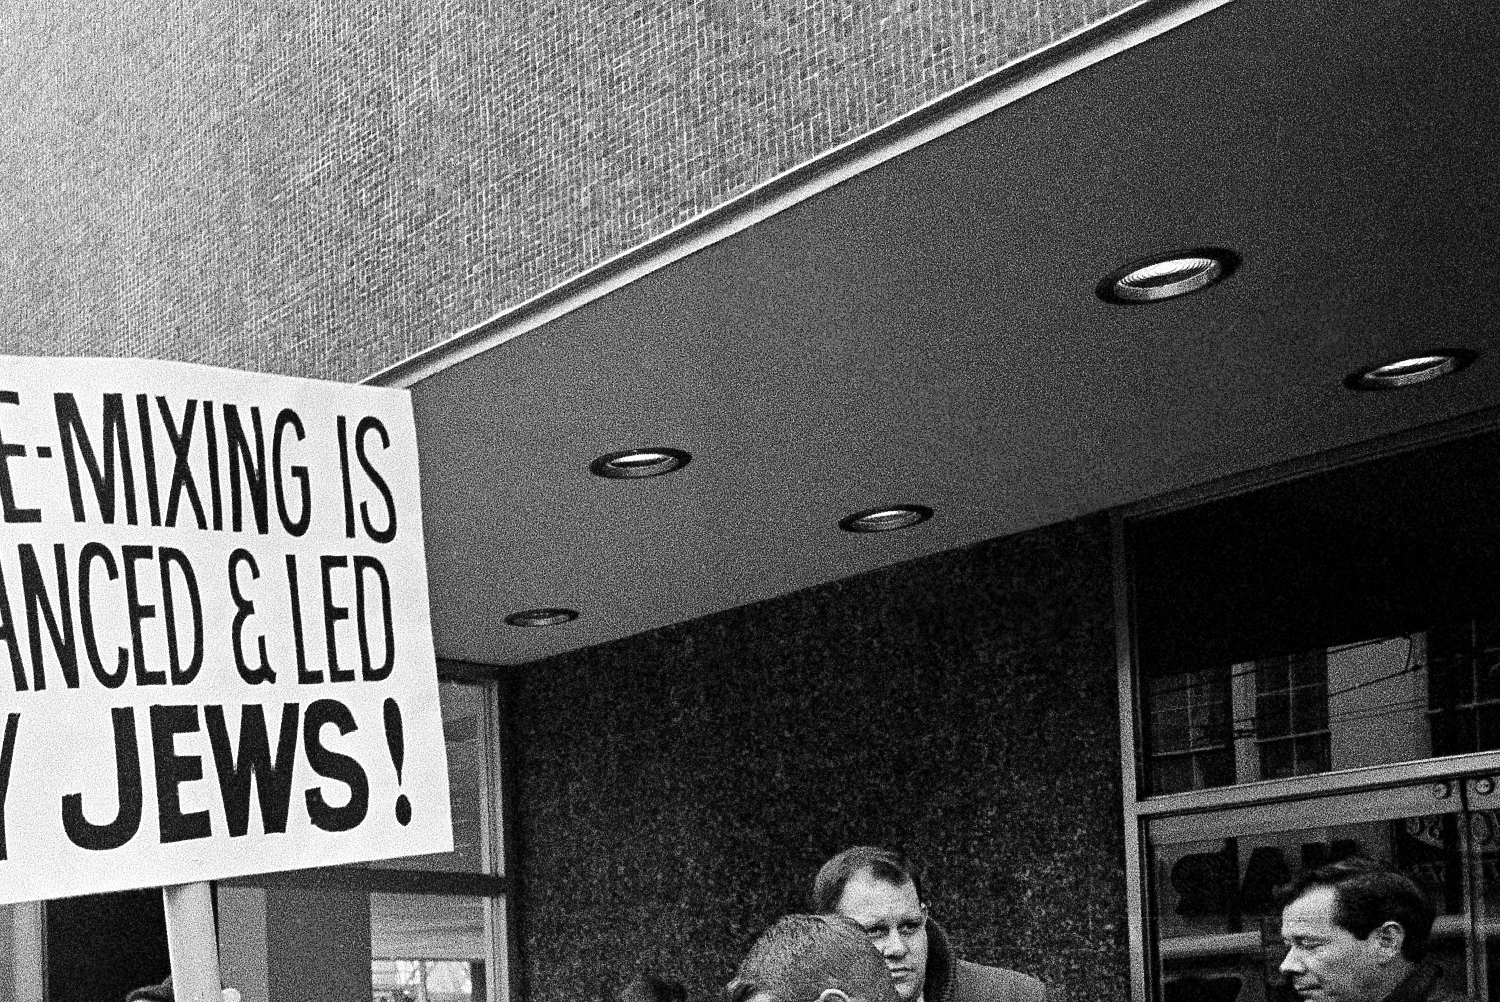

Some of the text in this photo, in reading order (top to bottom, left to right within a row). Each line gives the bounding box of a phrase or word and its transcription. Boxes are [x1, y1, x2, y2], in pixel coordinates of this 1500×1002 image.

[335, 414, 399, 545] IS
[226, 546, 278, 687] &
[284, 552, 397, 686] LED
[60, 696, 413, 852] JEWS!
